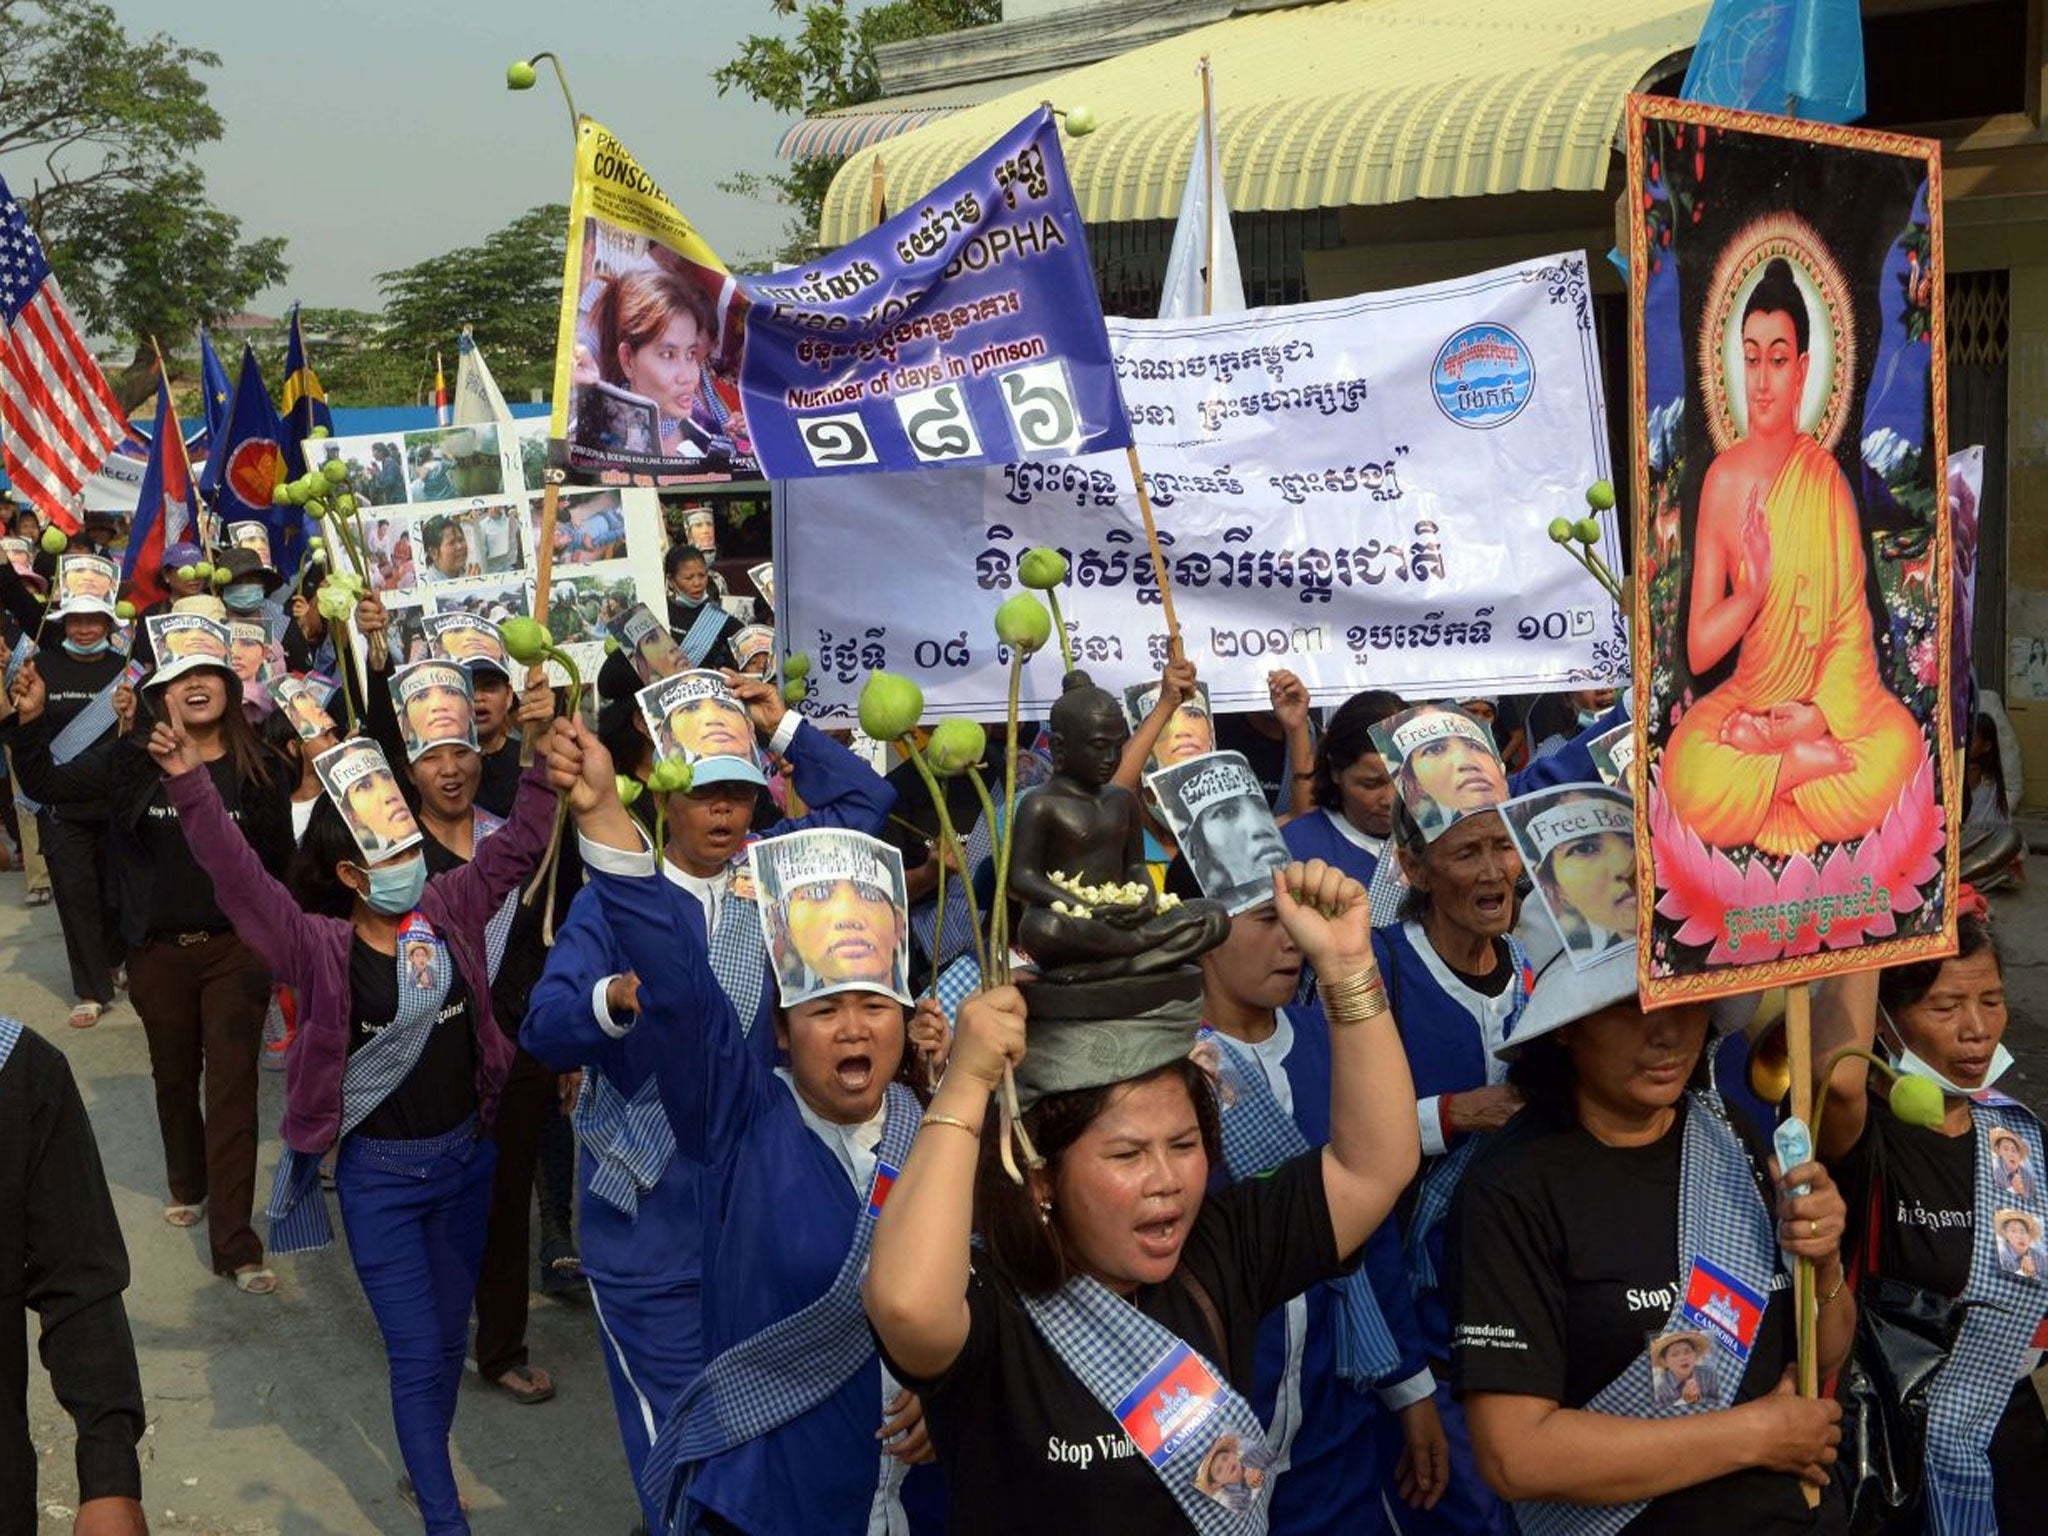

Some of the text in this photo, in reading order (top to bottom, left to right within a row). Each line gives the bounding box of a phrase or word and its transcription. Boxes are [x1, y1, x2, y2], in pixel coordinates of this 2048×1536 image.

[771, 302, 847, 331] Free
[786, 335, 1046, 410] Number of days in prinson
[1114, 340, 1314, 384] ជាណាចក្រកម្ពុជា
[975, 520, 1446, 604] ទិាសិទ្ធិនារីអន្តរជាតិ
[1396, 722, 1440, 748] Free
[1532, 815, 1589, 843] Free
[1626, 1287, 1673, 1312] Stop
[1693, 1311, 1740, 1352] CAMBODIA
[1163, 1400, 1219, 1454] CAMBODIA
[1047, 1433, 1137, 1470] Stop Viol
